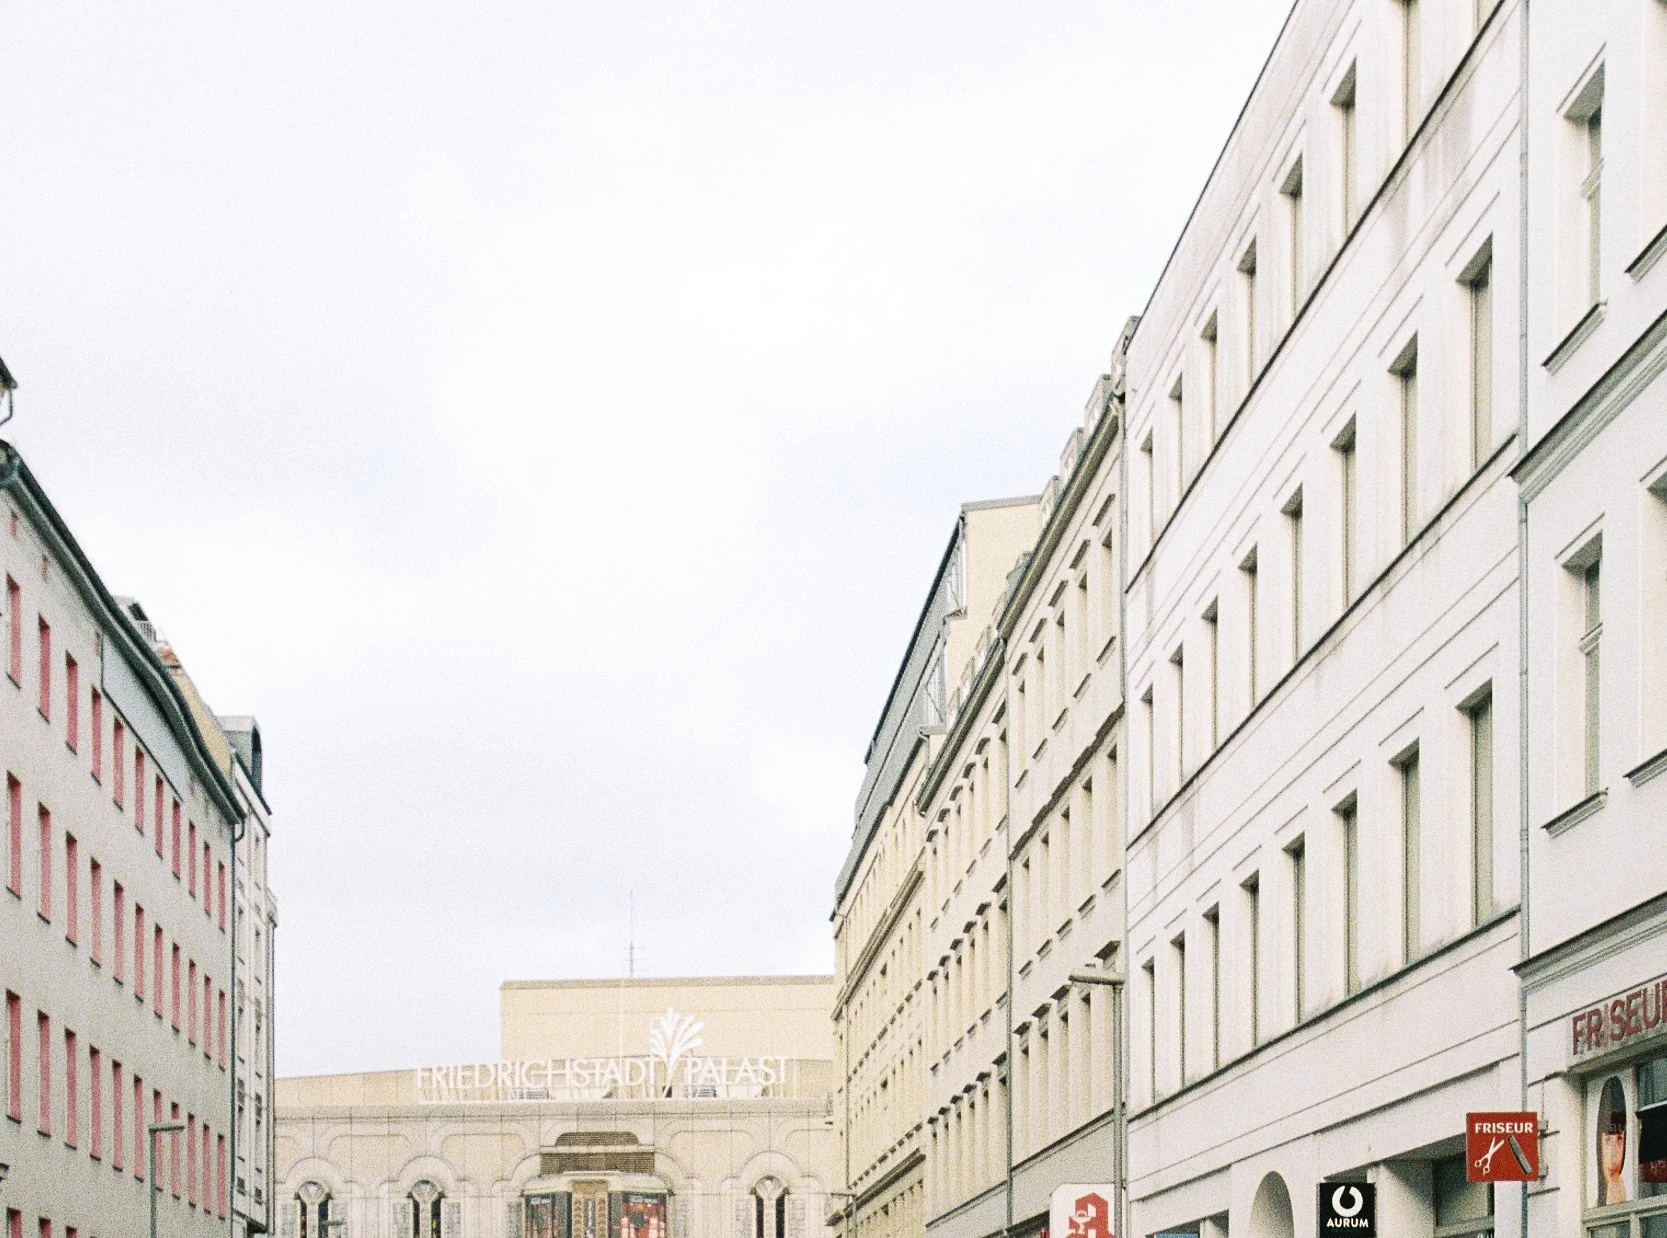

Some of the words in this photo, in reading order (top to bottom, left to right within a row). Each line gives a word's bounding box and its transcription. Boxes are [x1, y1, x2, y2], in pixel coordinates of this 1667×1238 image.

[686, 1056, 791, 1086] PALAST
[1474, 1122, 1534, 1134] FRISEUR
[1326, 1217, 1369, 1228] AURUM
